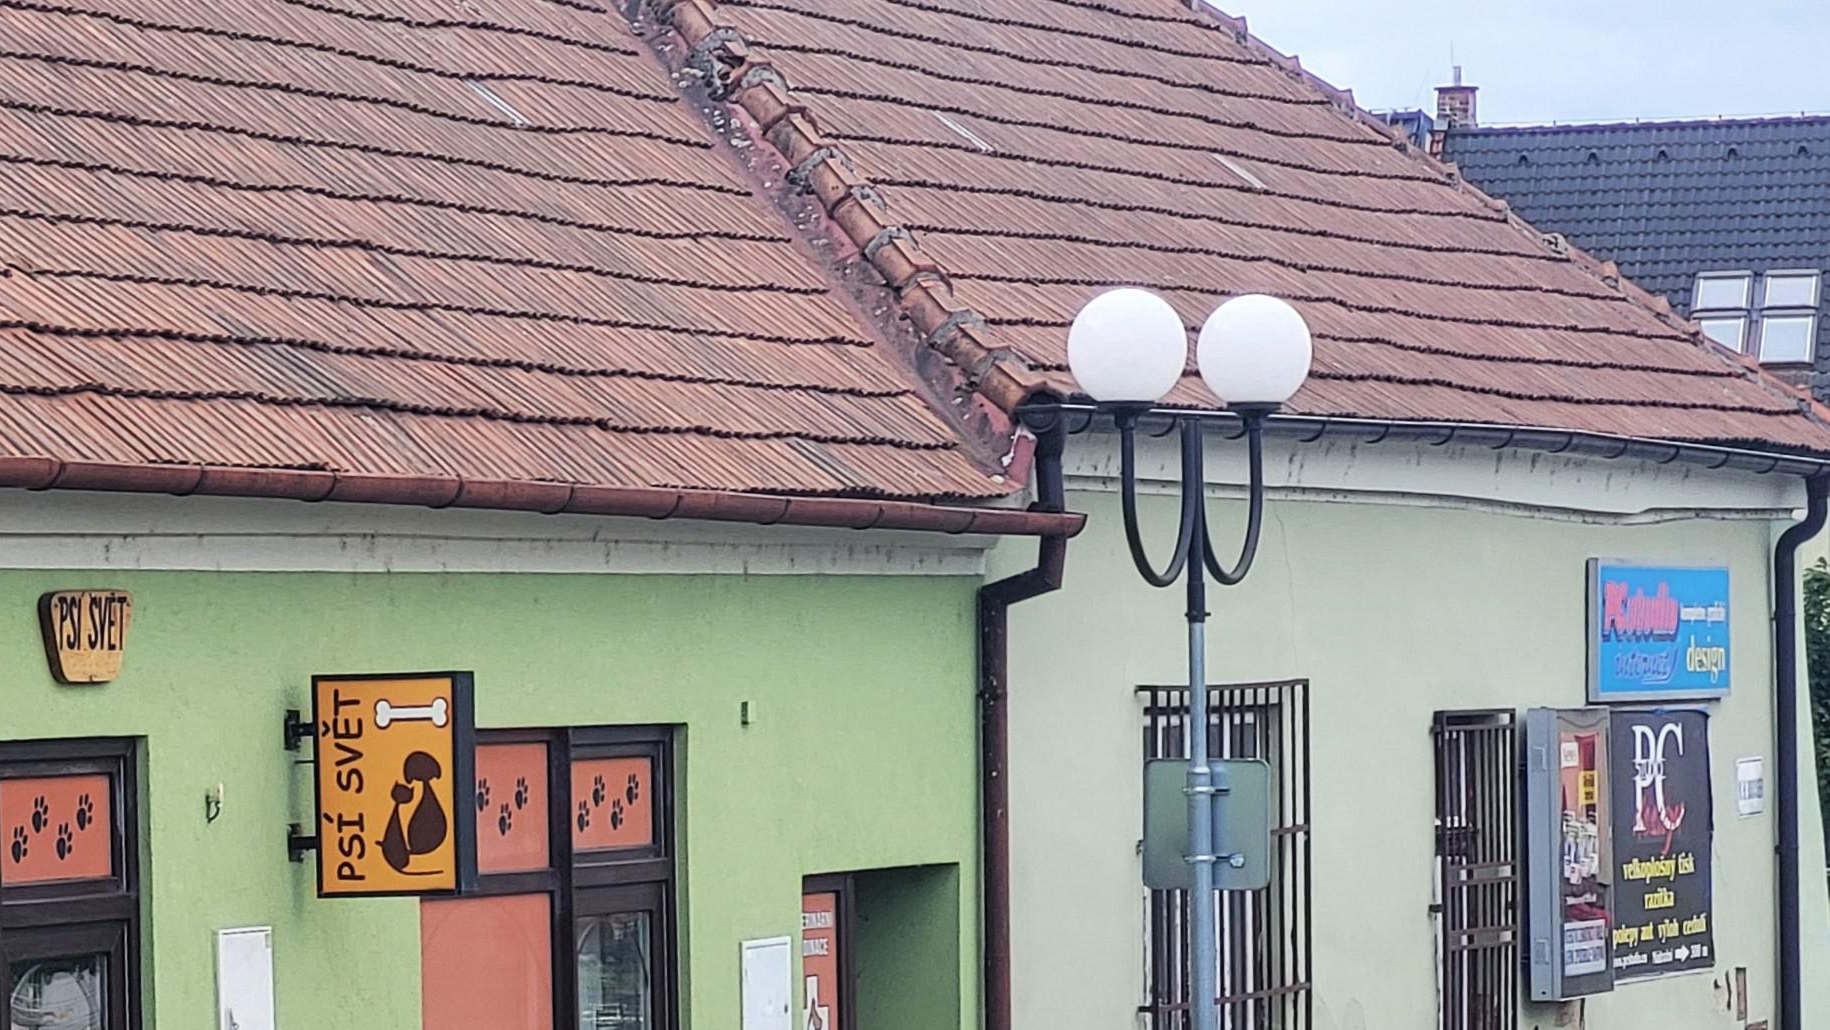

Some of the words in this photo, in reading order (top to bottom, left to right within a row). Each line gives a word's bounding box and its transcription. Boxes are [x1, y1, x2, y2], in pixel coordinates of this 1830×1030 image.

[57, 591, 85, 651] PSÍ
[1686, 634, 1726, 684] design
[321, 688, 365, 795] SVĚT
[1631, 722, 1686, 832] PC
[322, 811, 366, 882] PSÍ
